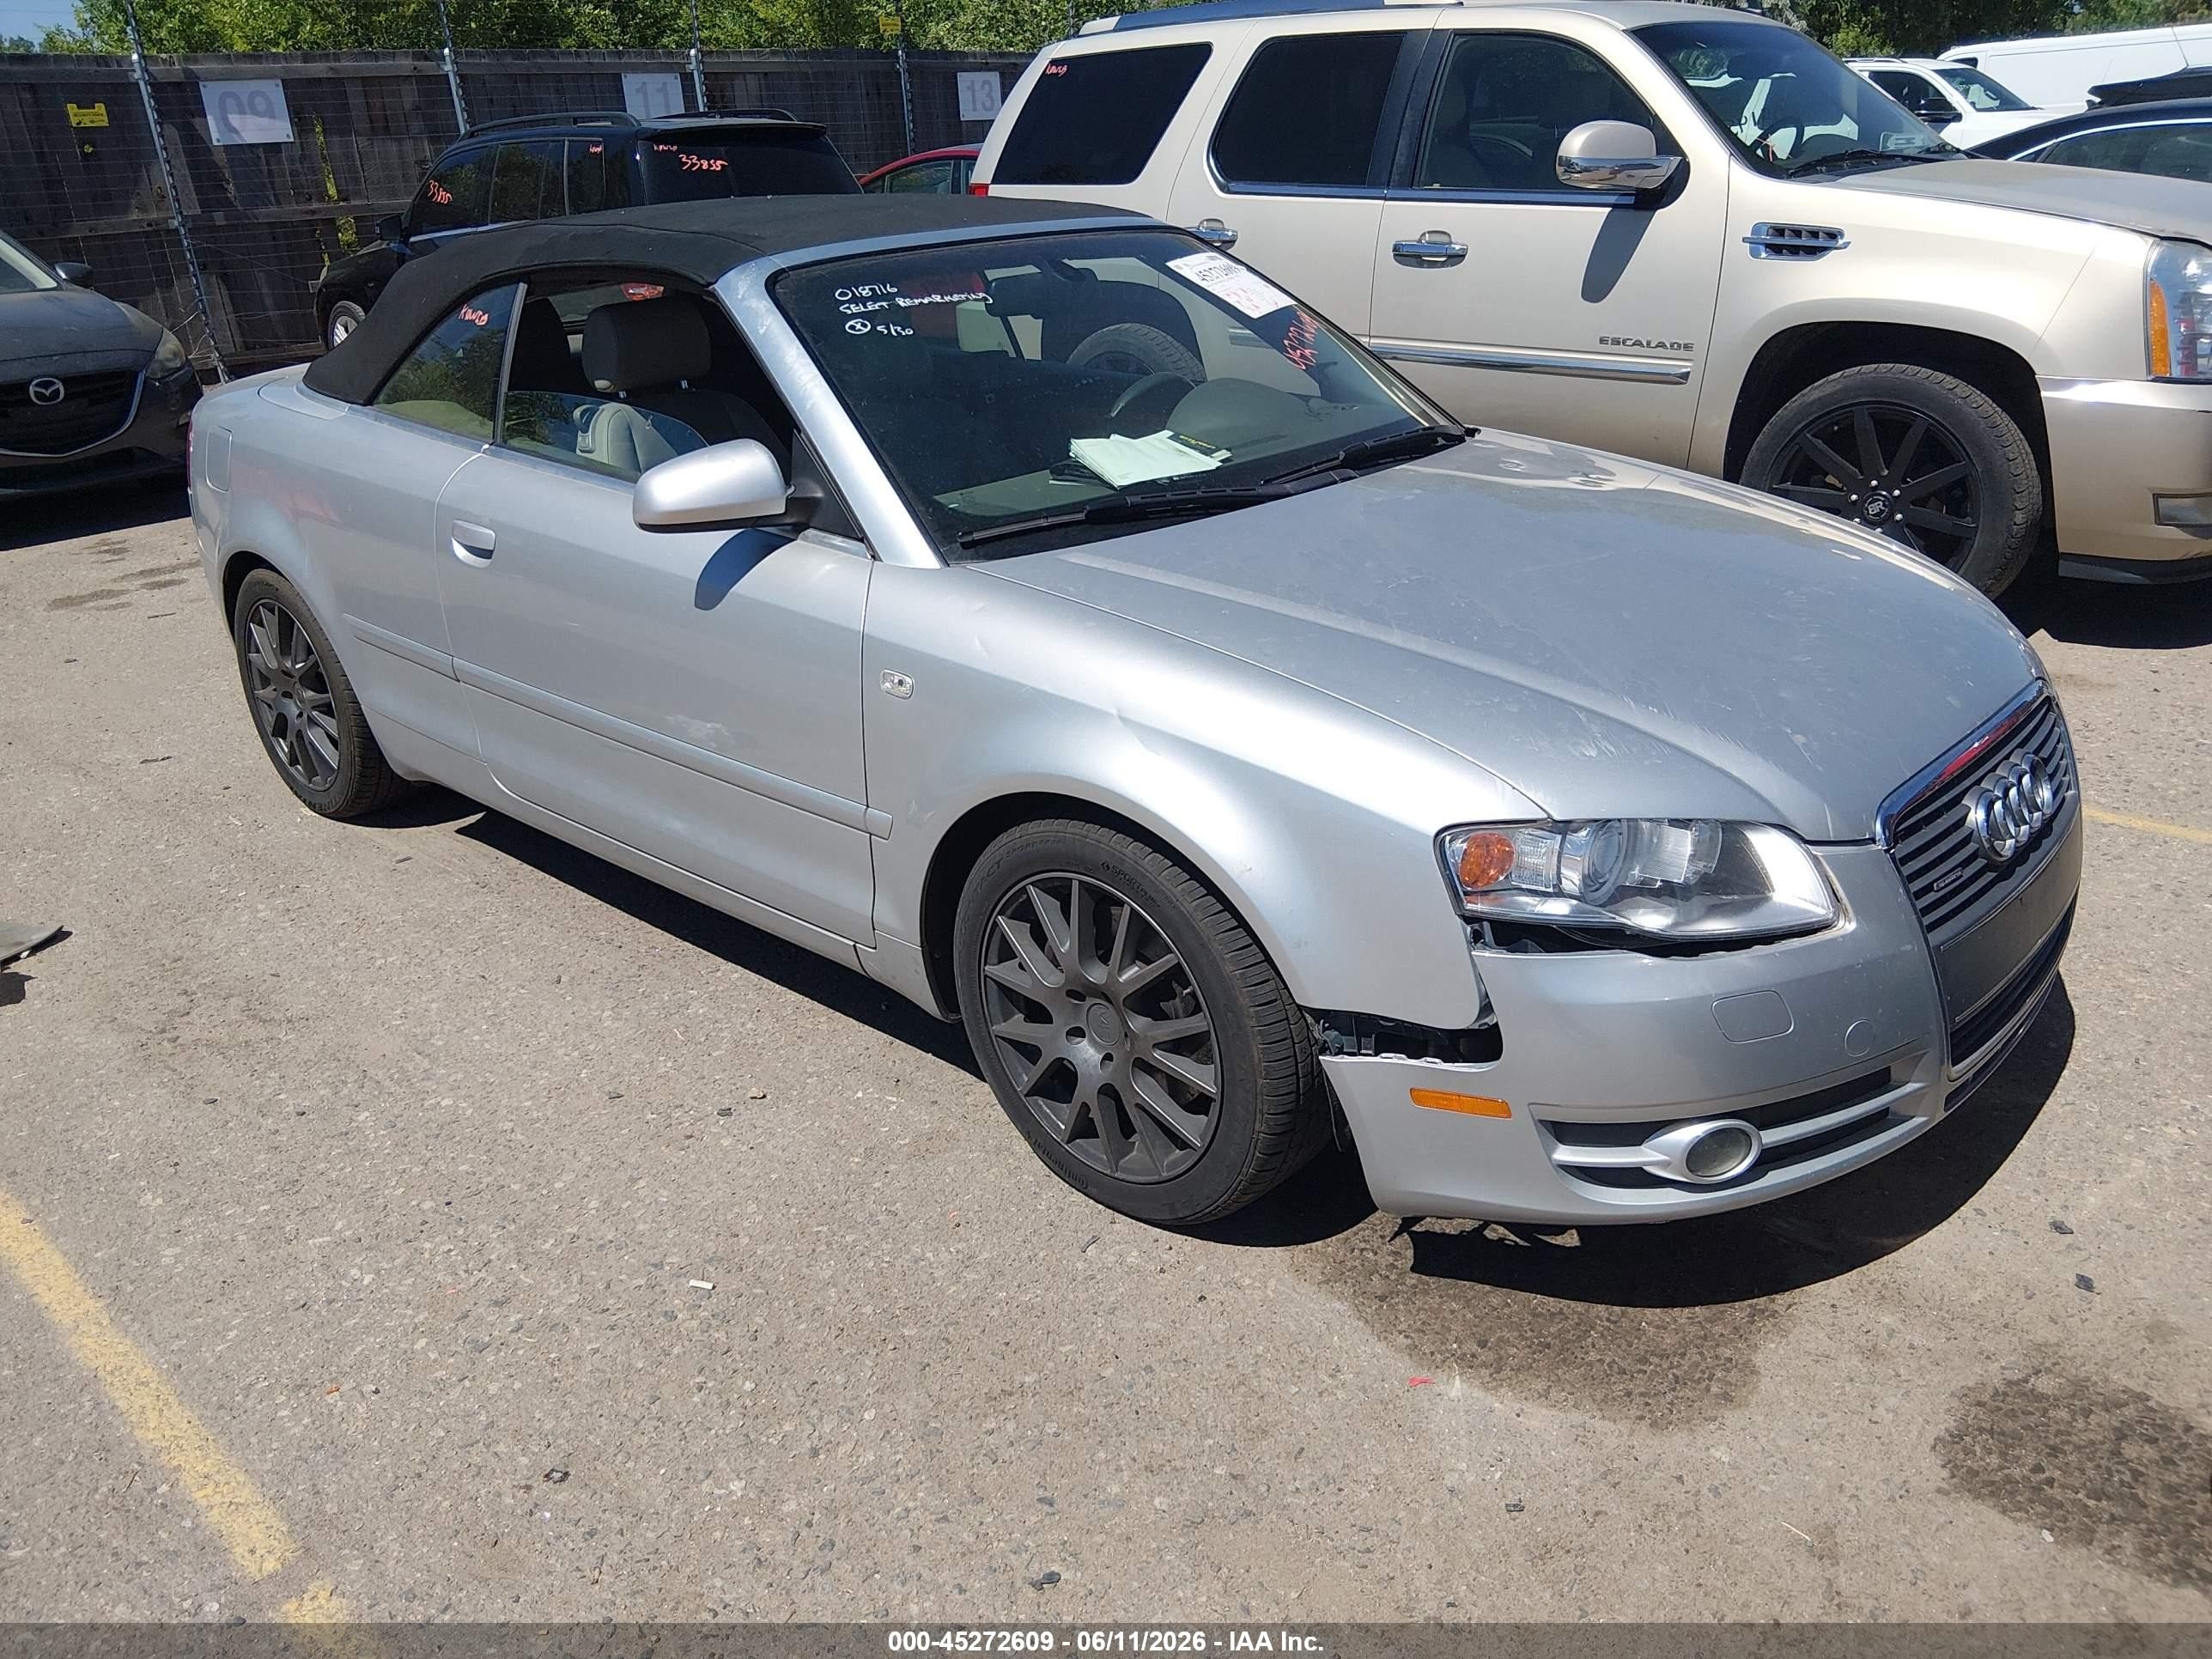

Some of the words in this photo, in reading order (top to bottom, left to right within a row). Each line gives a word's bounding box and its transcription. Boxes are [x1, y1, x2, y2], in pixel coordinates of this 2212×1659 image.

[635, 81, 672, 118] 11
[967, 80, 994, 112] 13
[678, 154, 729, 171] 33855
[876, 322, 915, 337] 5/30
[1599, 336, 1695, 352] ESCALADE
